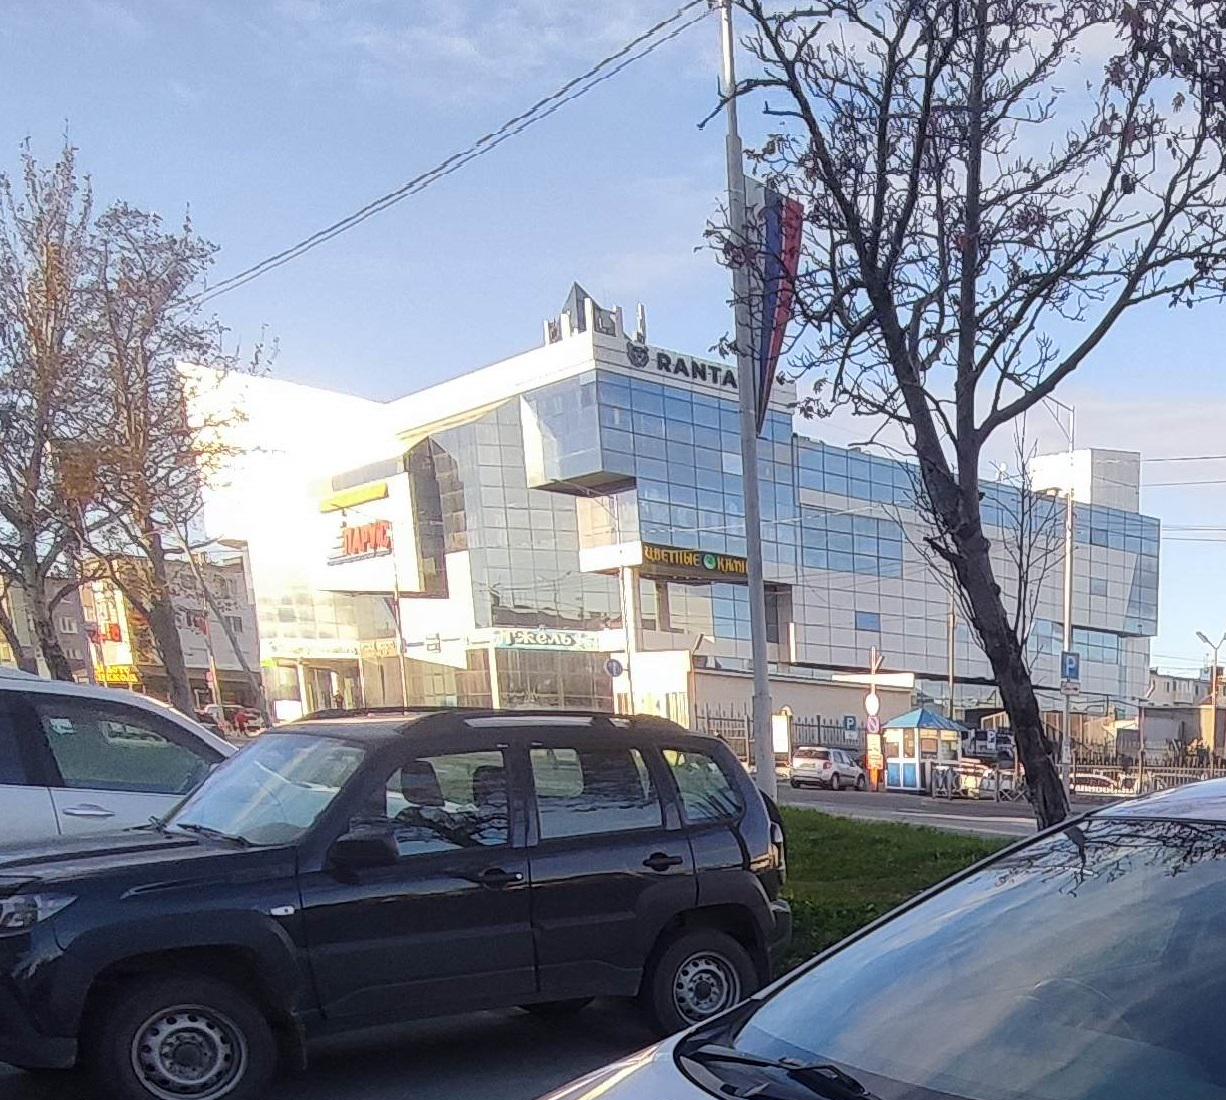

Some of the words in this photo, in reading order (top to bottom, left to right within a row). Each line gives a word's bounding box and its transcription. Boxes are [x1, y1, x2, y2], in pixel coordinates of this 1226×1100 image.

[656, 352, 738, 389] RANTA
[644, 546, 701, 567] ЦВЕТНЫЕ
[717, 556, 749, 574] КАМ
